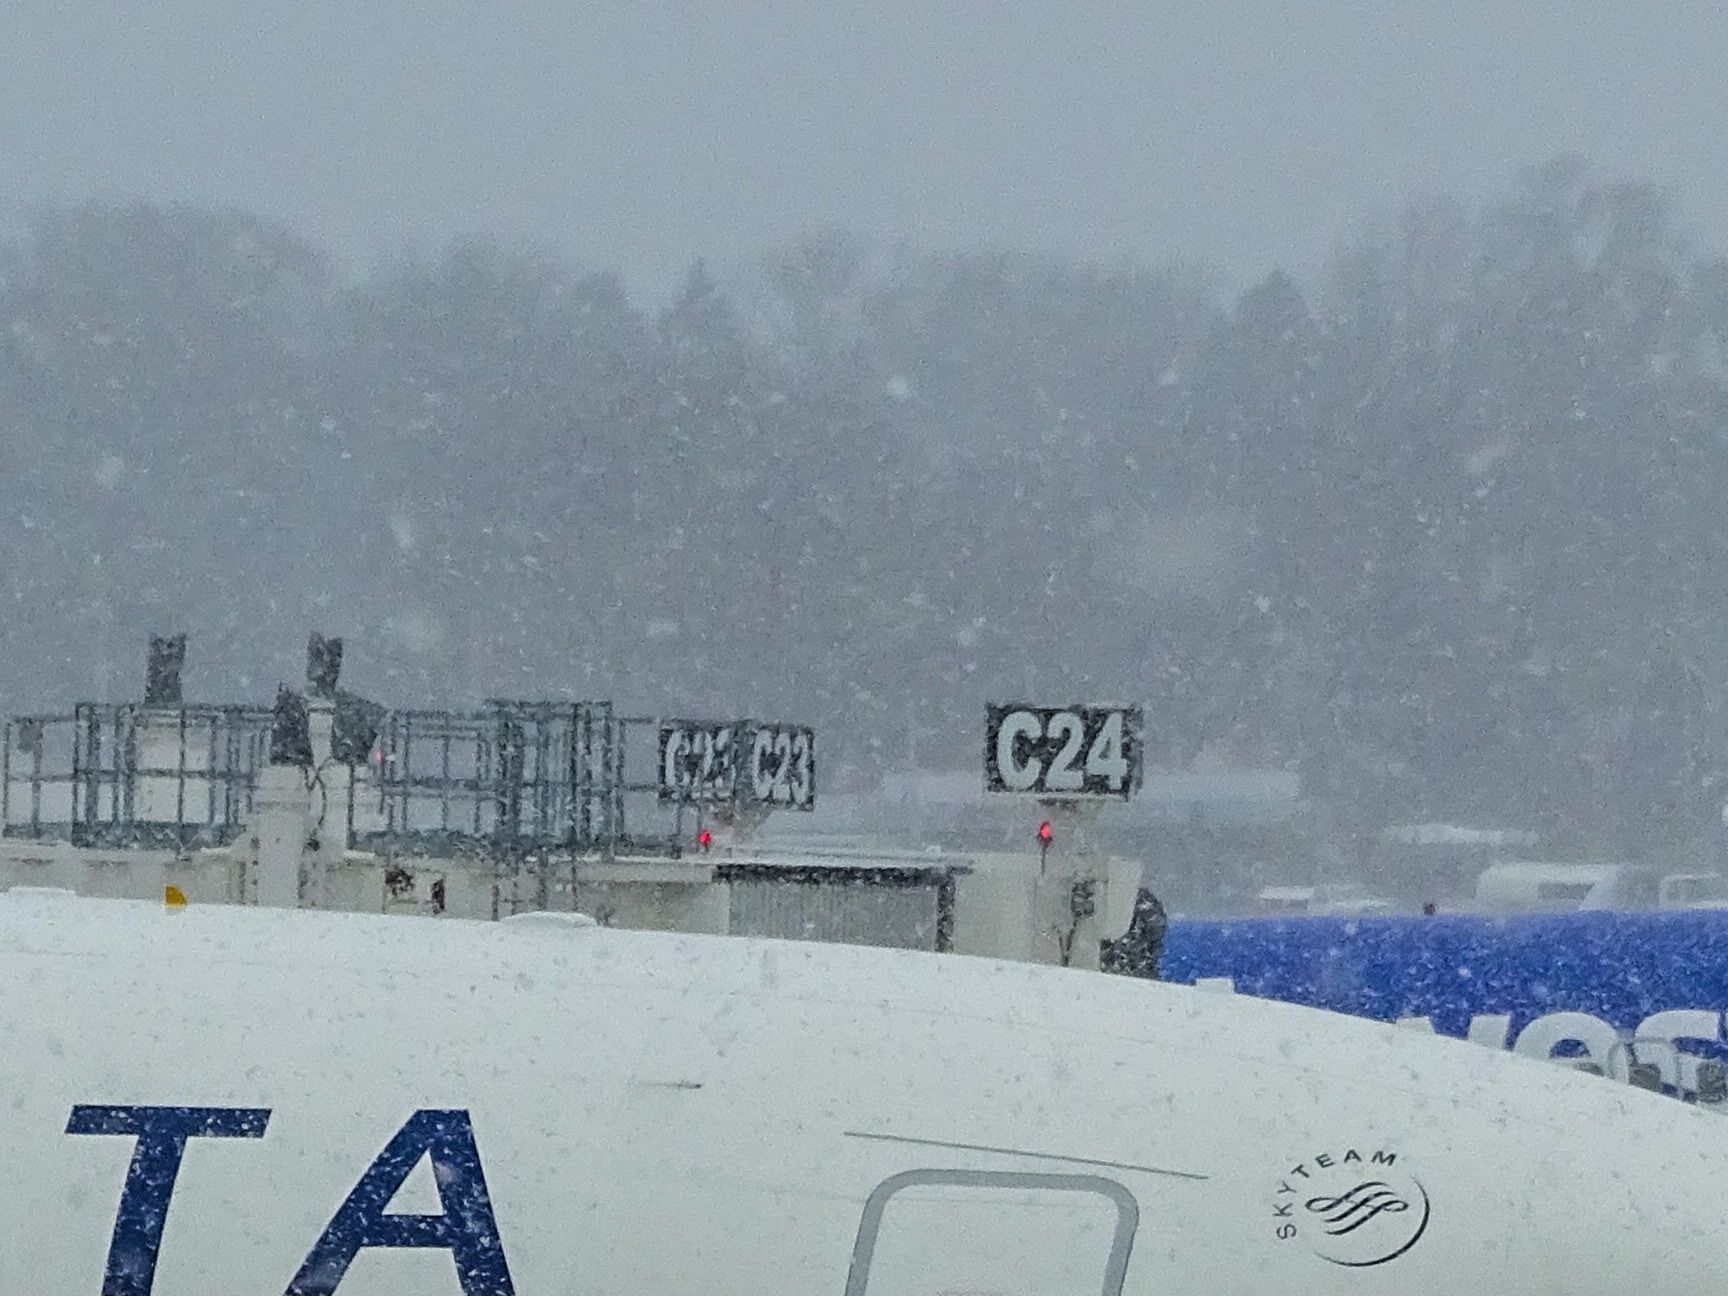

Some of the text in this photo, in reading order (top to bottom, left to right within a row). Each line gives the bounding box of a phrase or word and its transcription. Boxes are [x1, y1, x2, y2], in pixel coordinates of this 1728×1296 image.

[752, 730, 809, 803] C23
[997, 711, 1128, 790] C24
[1272, 1149, 1397, 1240] SKYTEAM
